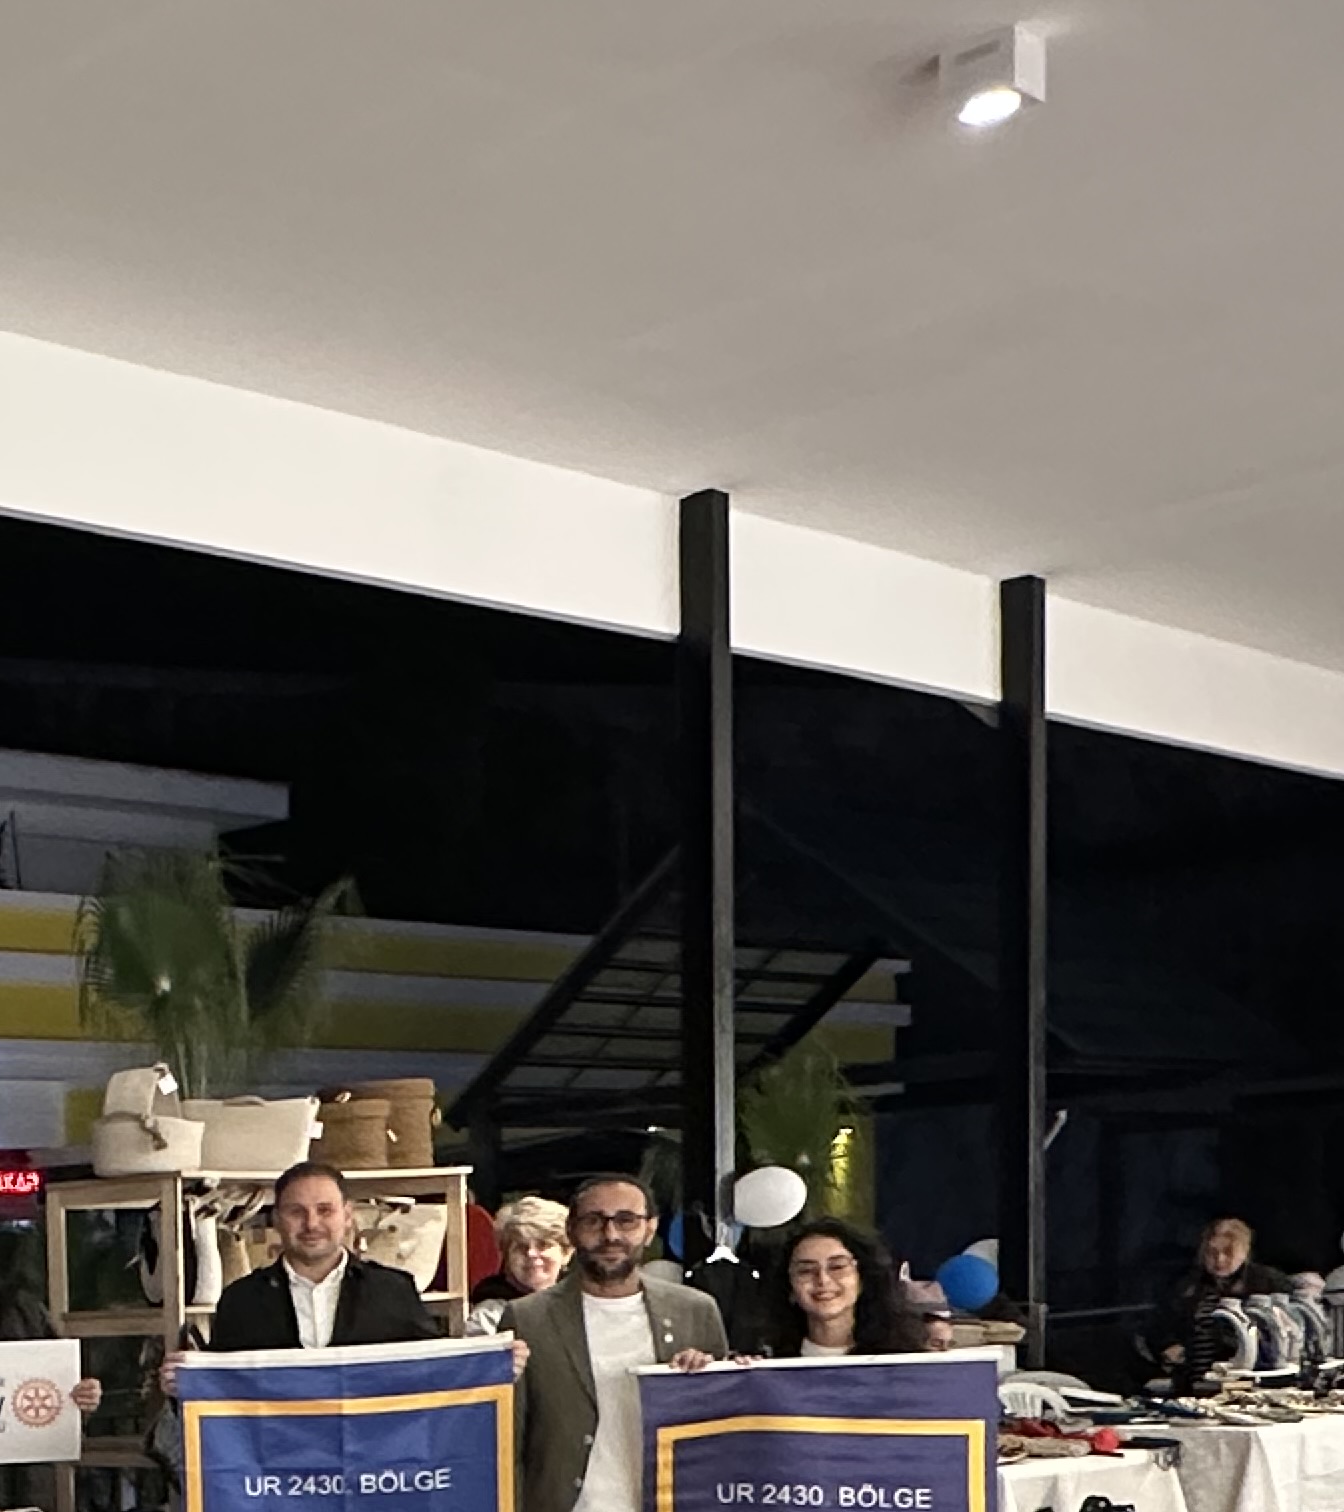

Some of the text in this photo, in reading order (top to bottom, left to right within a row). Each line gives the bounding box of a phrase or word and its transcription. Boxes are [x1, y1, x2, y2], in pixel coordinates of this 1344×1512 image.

[244, 1475, 283, 1496] UR
[360, 1467, 452, 1495] BÖLGE
[716, 1482, 755, 1503] UR
[838, 1484, 933, 1510] BÖLGE
